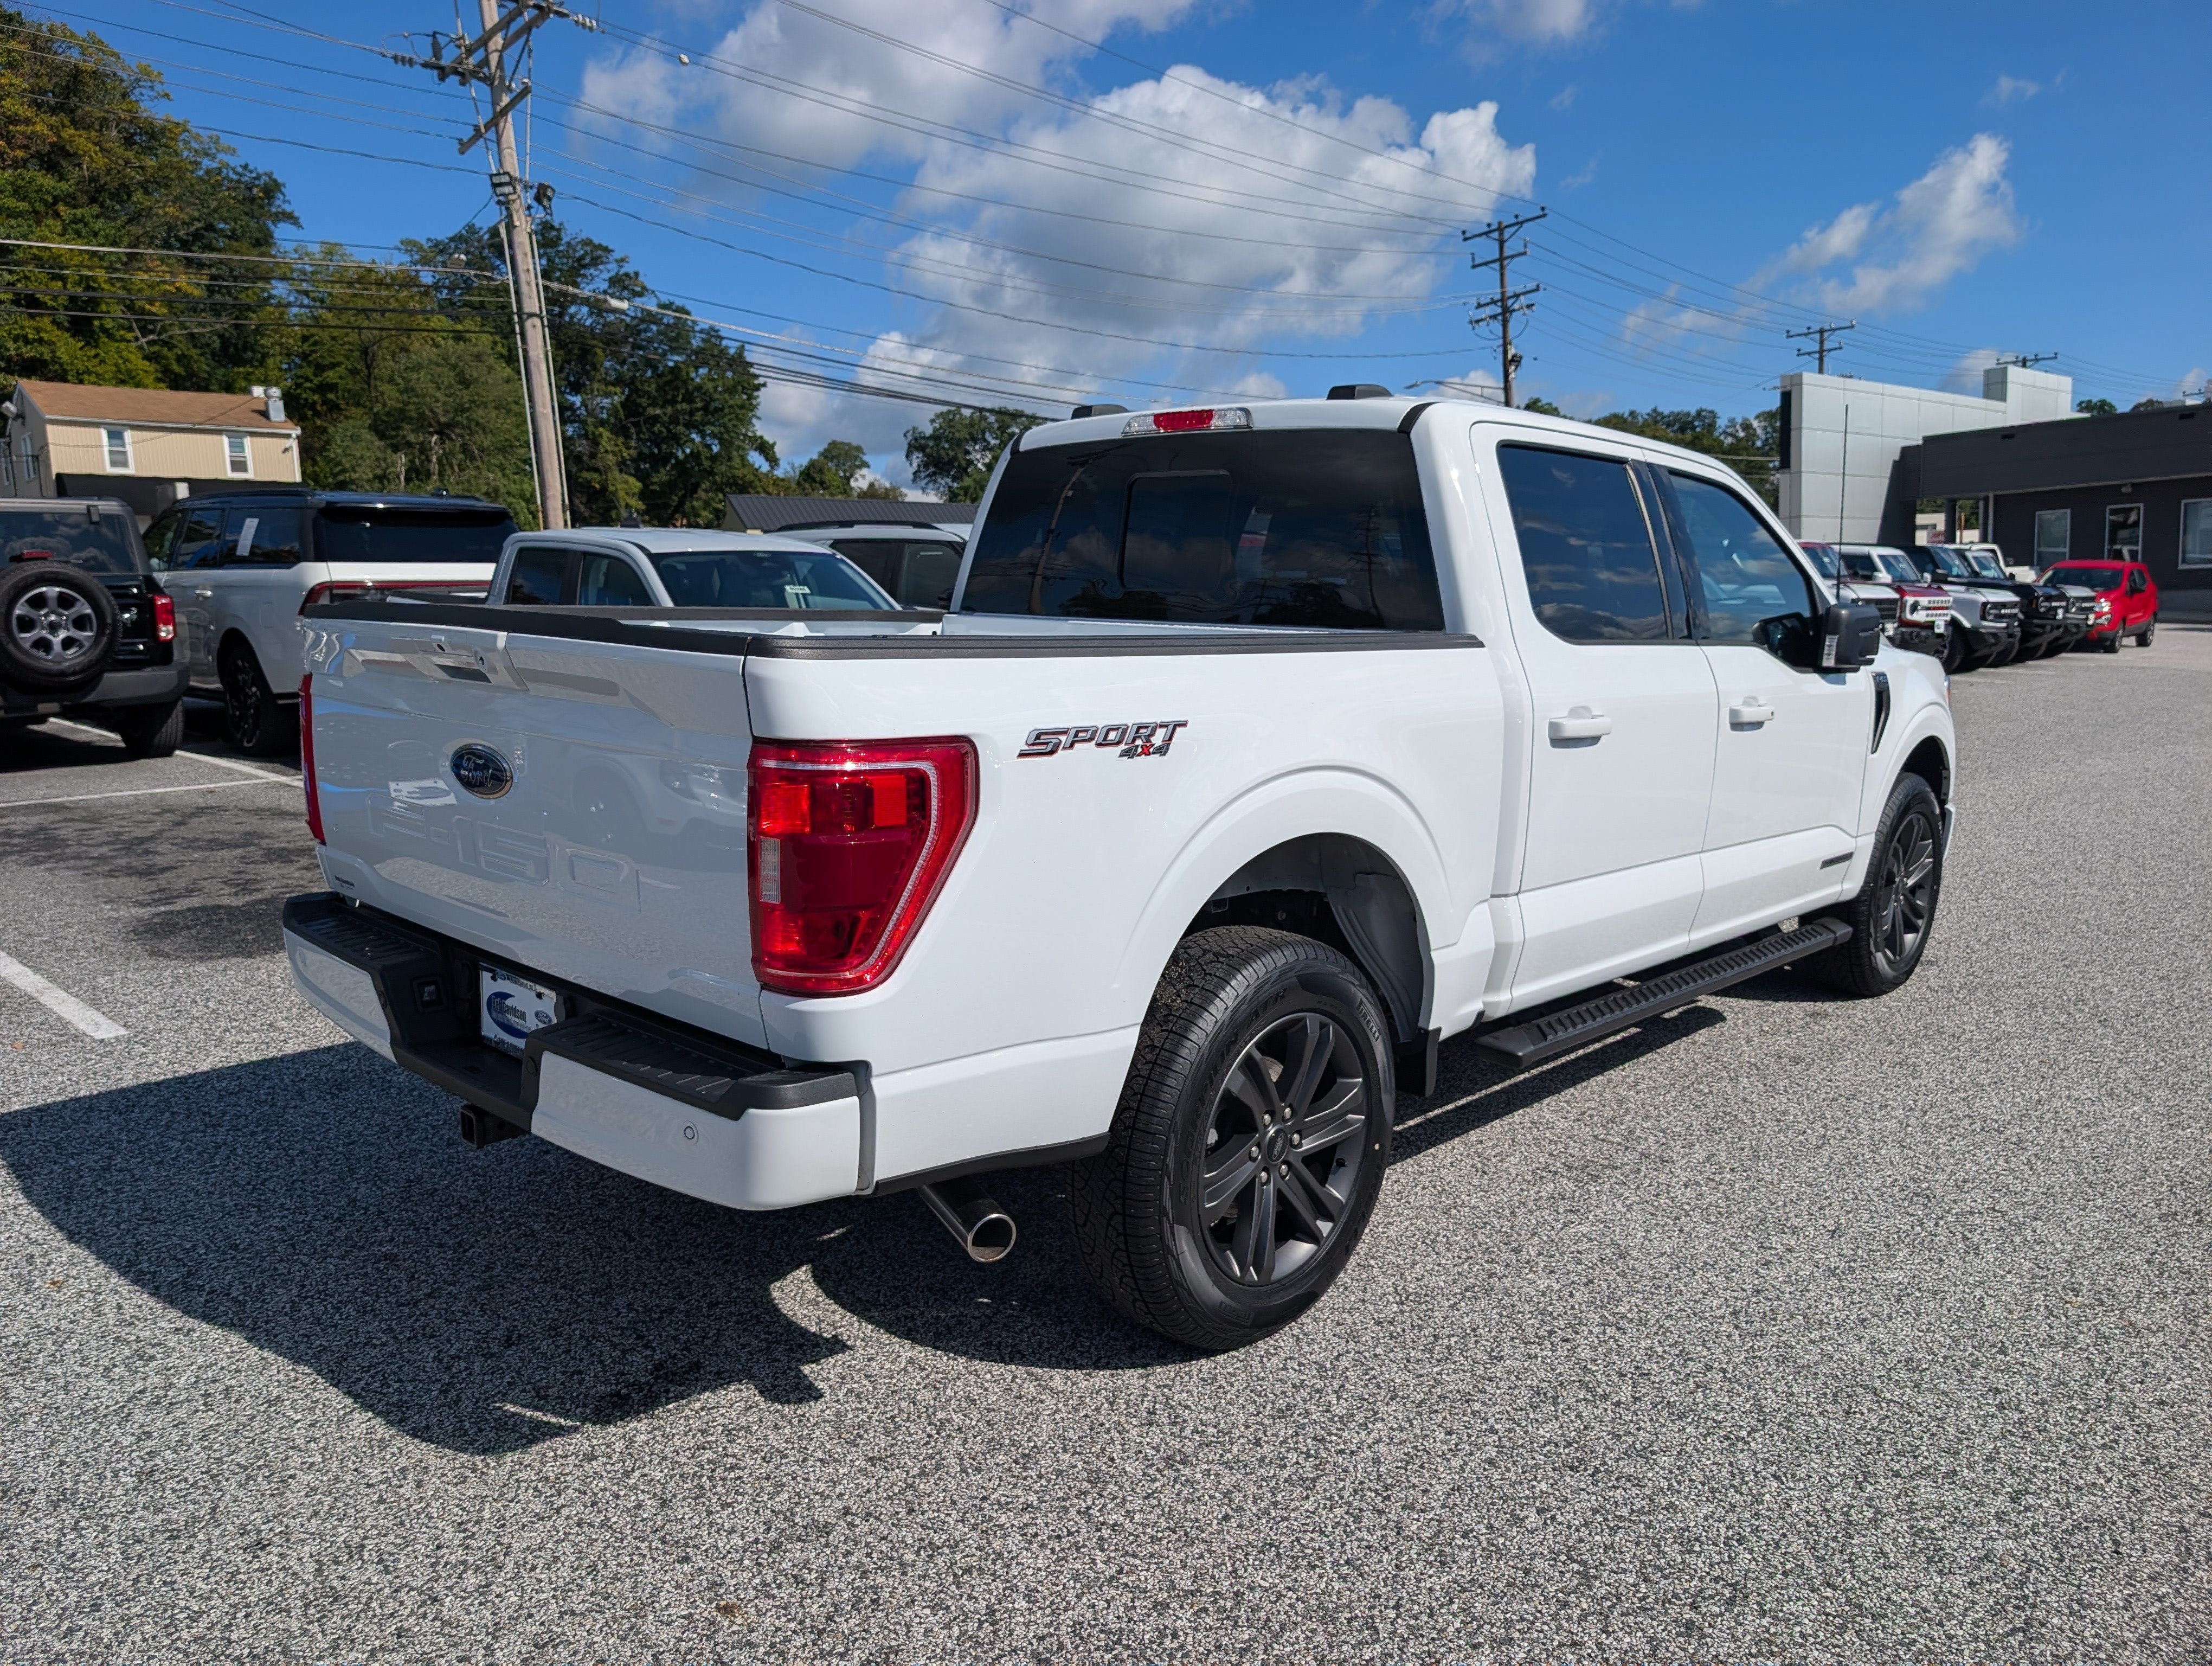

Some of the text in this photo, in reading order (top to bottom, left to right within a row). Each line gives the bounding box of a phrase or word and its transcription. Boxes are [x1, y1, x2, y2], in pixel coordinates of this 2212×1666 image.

[1017, 720, 1189, 759] SPORT
[459, 754, 494, 787] Ford
[503, 1001, 526, 1022] Davidson
[1356, 998, 1381, 1042] PIRELLI
